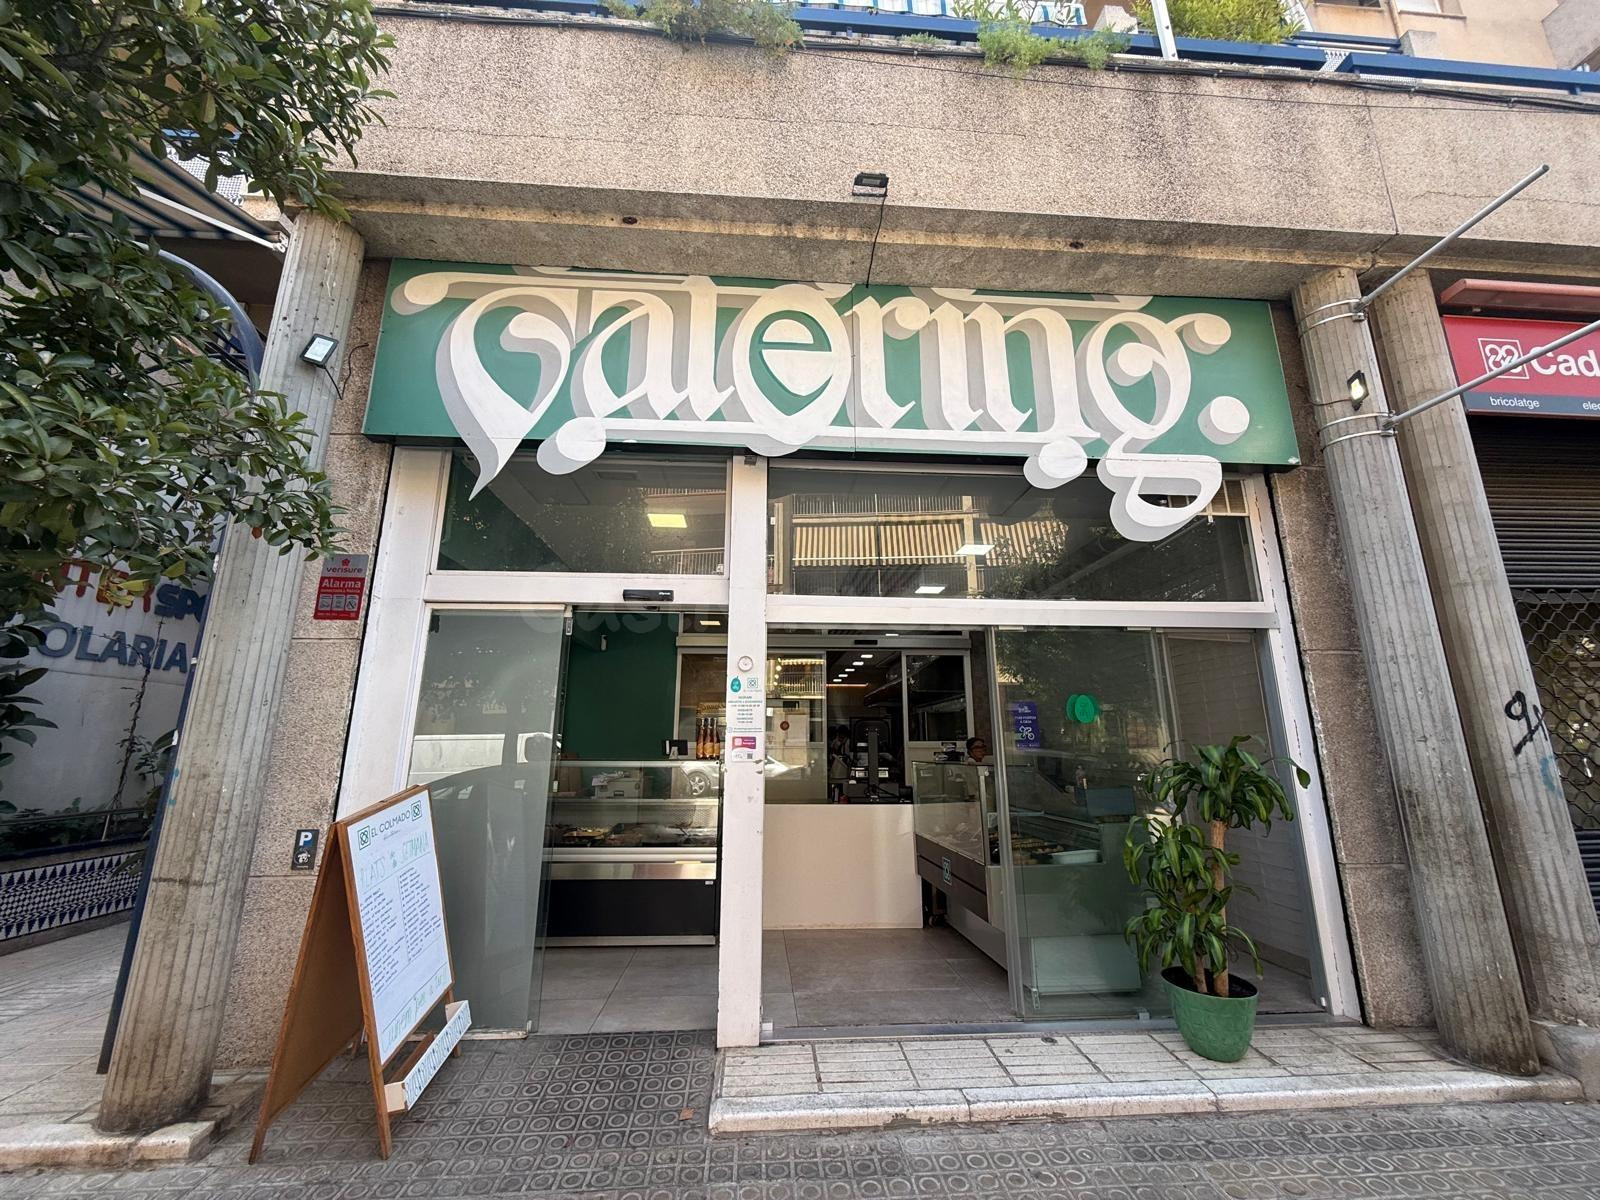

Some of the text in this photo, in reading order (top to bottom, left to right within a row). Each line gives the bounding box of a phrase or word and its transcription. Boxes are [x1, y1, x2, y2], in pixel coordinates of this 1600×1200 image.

[1489, 396, 1540, 409] bricolatge
[321, 578, 361, 587] Alarma
[371, 827, 378, 838] EL
[379, 810, 410, 832] COLMADO
[299, 831, 313, 846] P
